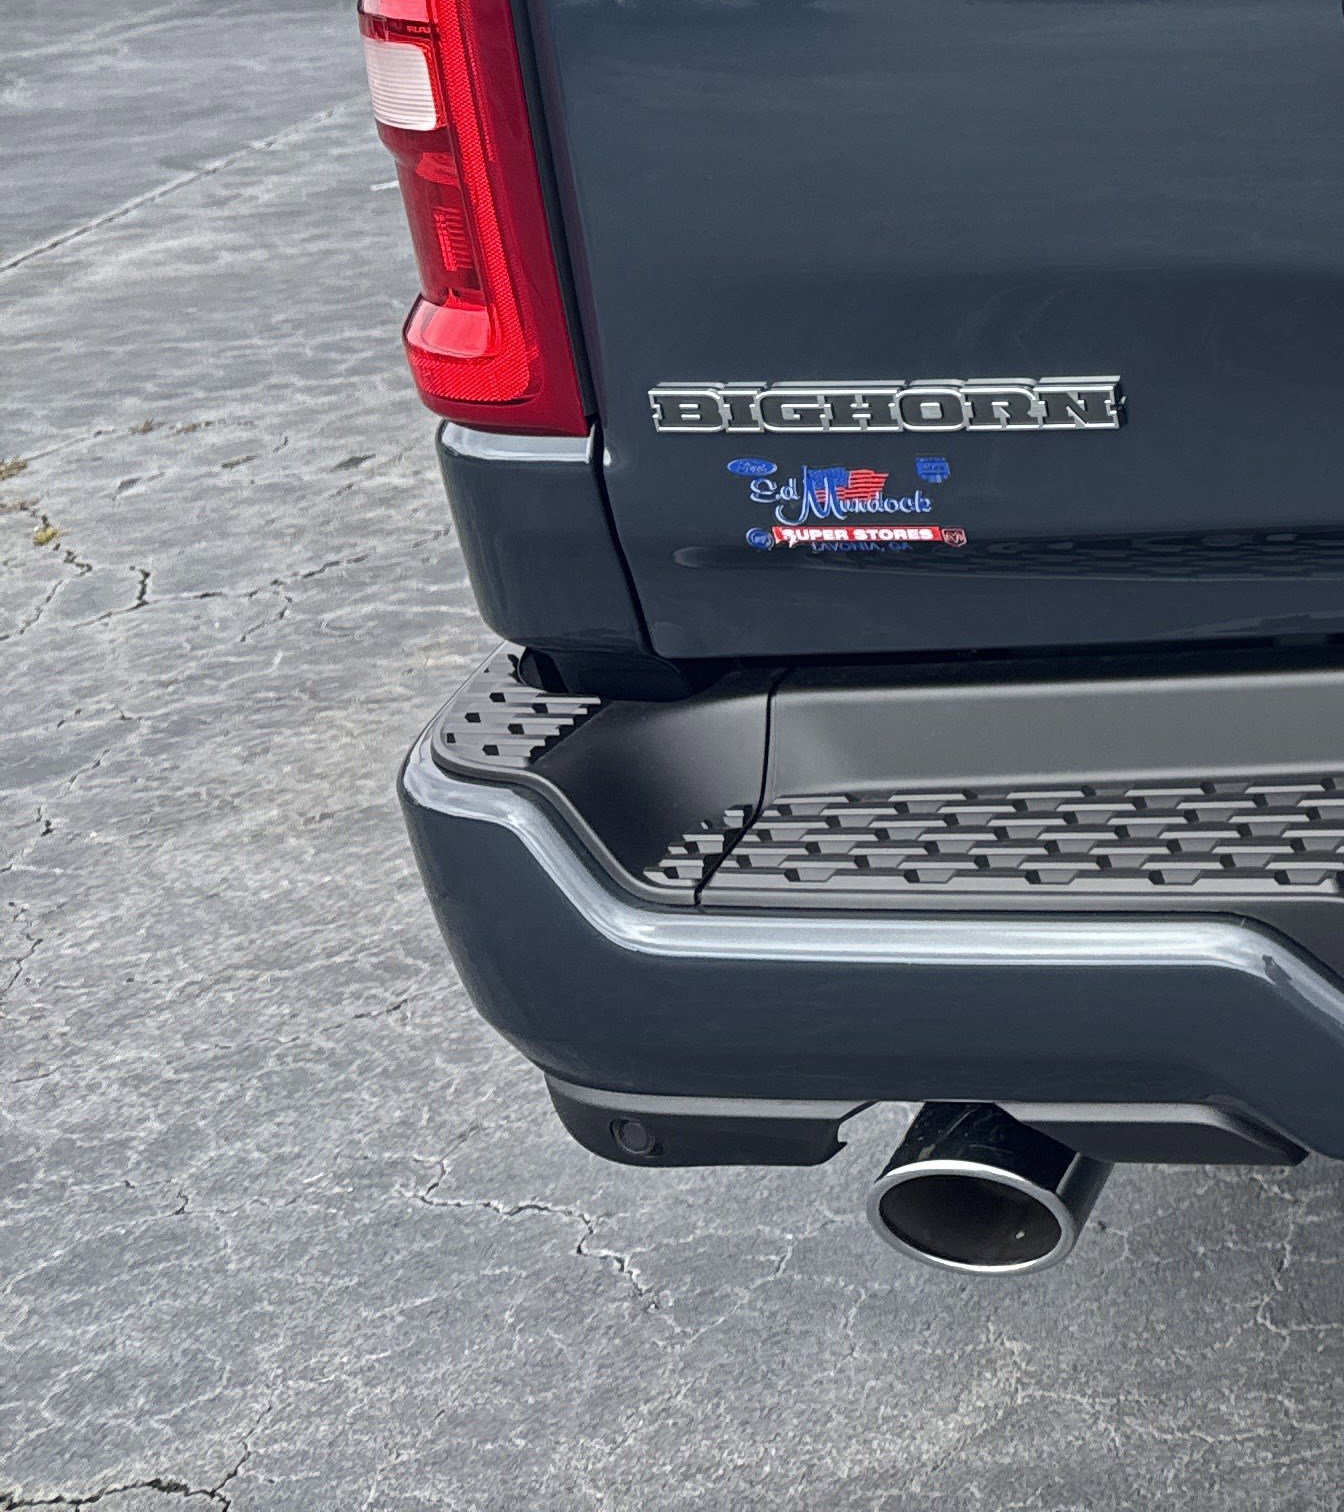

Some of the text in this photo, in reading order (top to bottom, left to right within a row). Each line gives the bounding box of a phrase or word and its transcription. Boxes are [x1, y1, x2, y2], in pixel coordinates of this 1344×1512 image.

[648, 375, 1124, 432] BIGHORN
[750, 472, 932, 526] Ed Murdock
[782, 527, 935, 544] SUPER STORES
